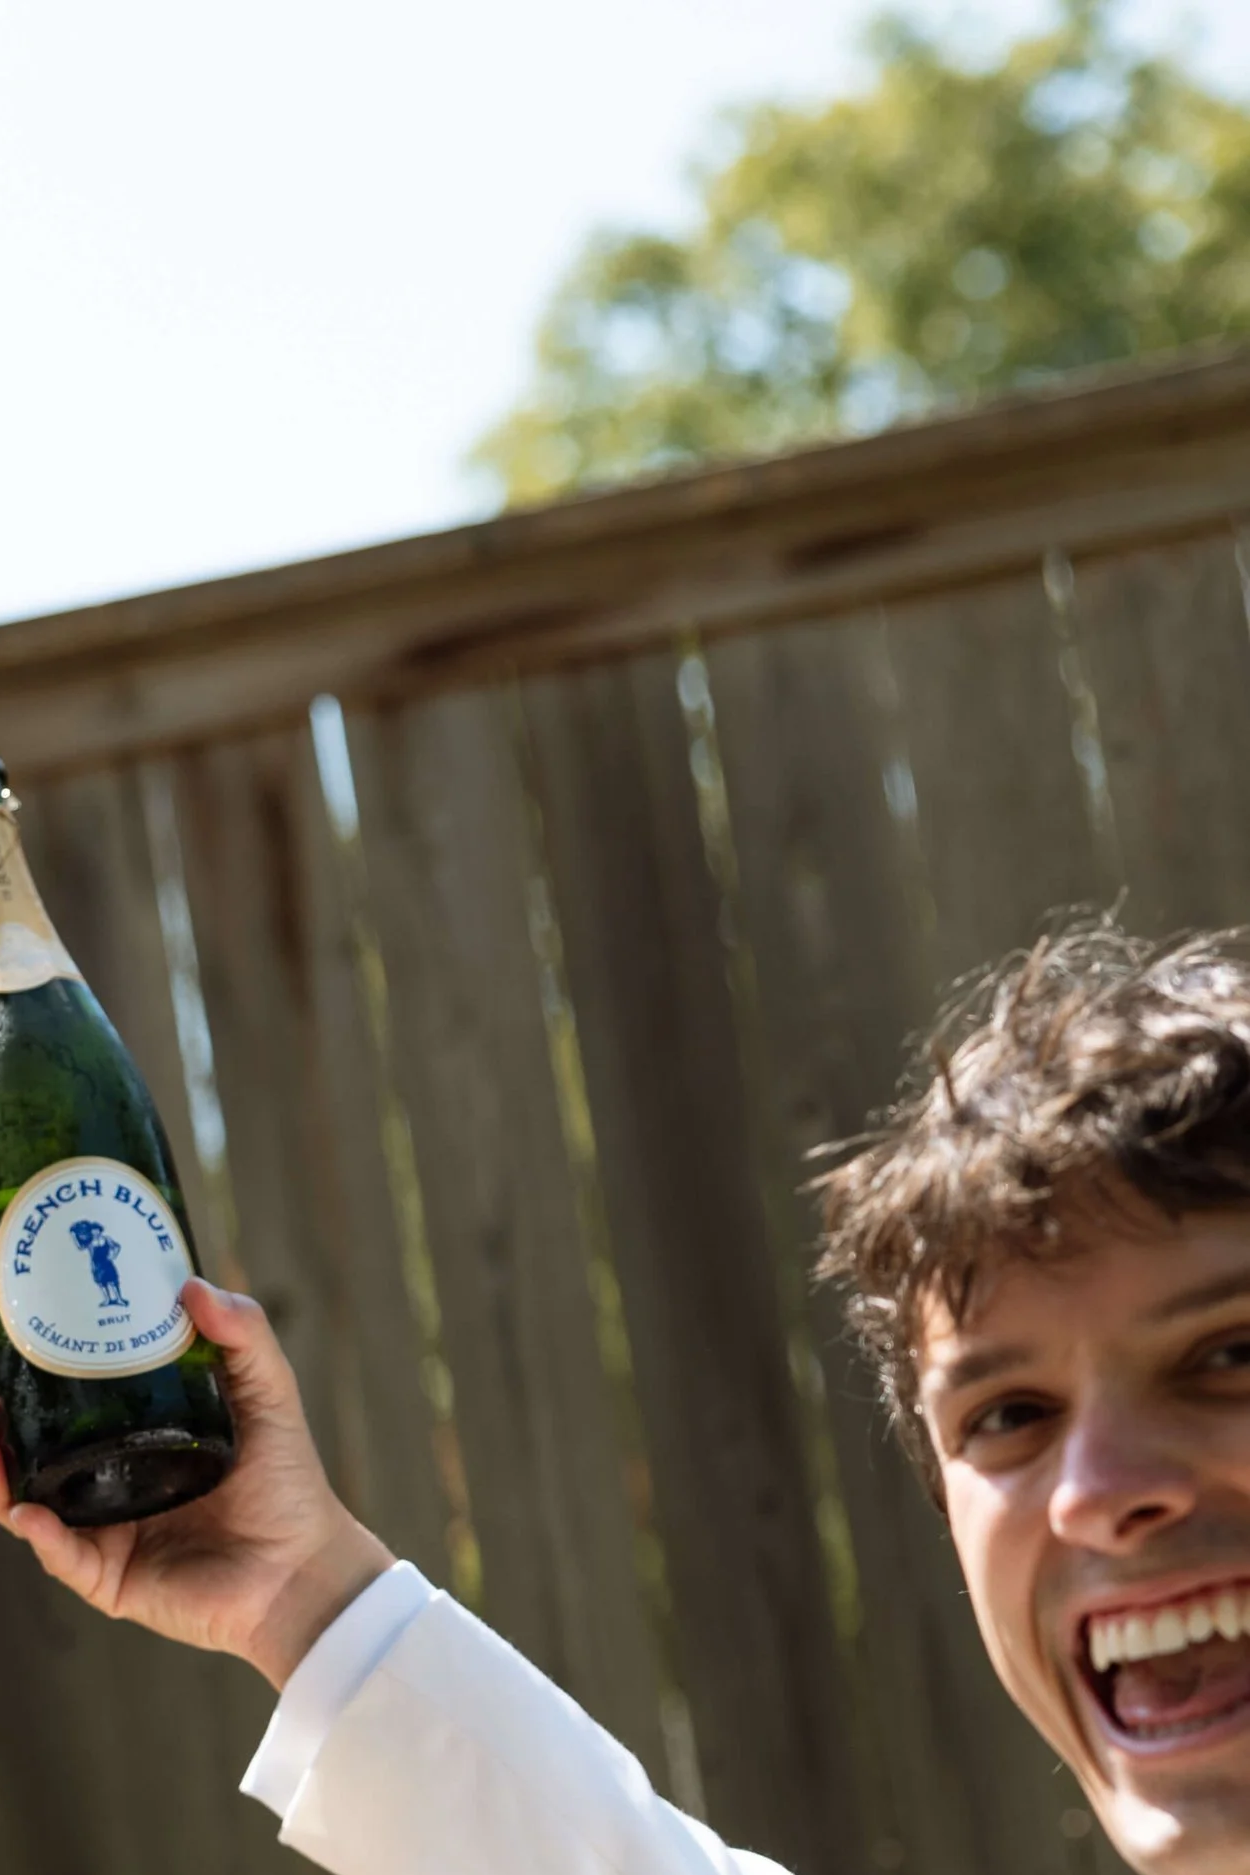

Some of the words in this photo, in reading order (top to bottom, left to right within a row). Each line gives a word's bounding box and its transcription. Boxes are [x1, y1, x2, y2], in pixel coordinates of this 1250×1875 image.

[13, 1179, 102, 1276] FRENCH
[114, 1184, 174, 1252] BLUE
[28, 1316, 100, 1354] CRÉMANT
[105, 1341, 126, 1354] DE
[98, 1314, 132, 1327] BRUT
